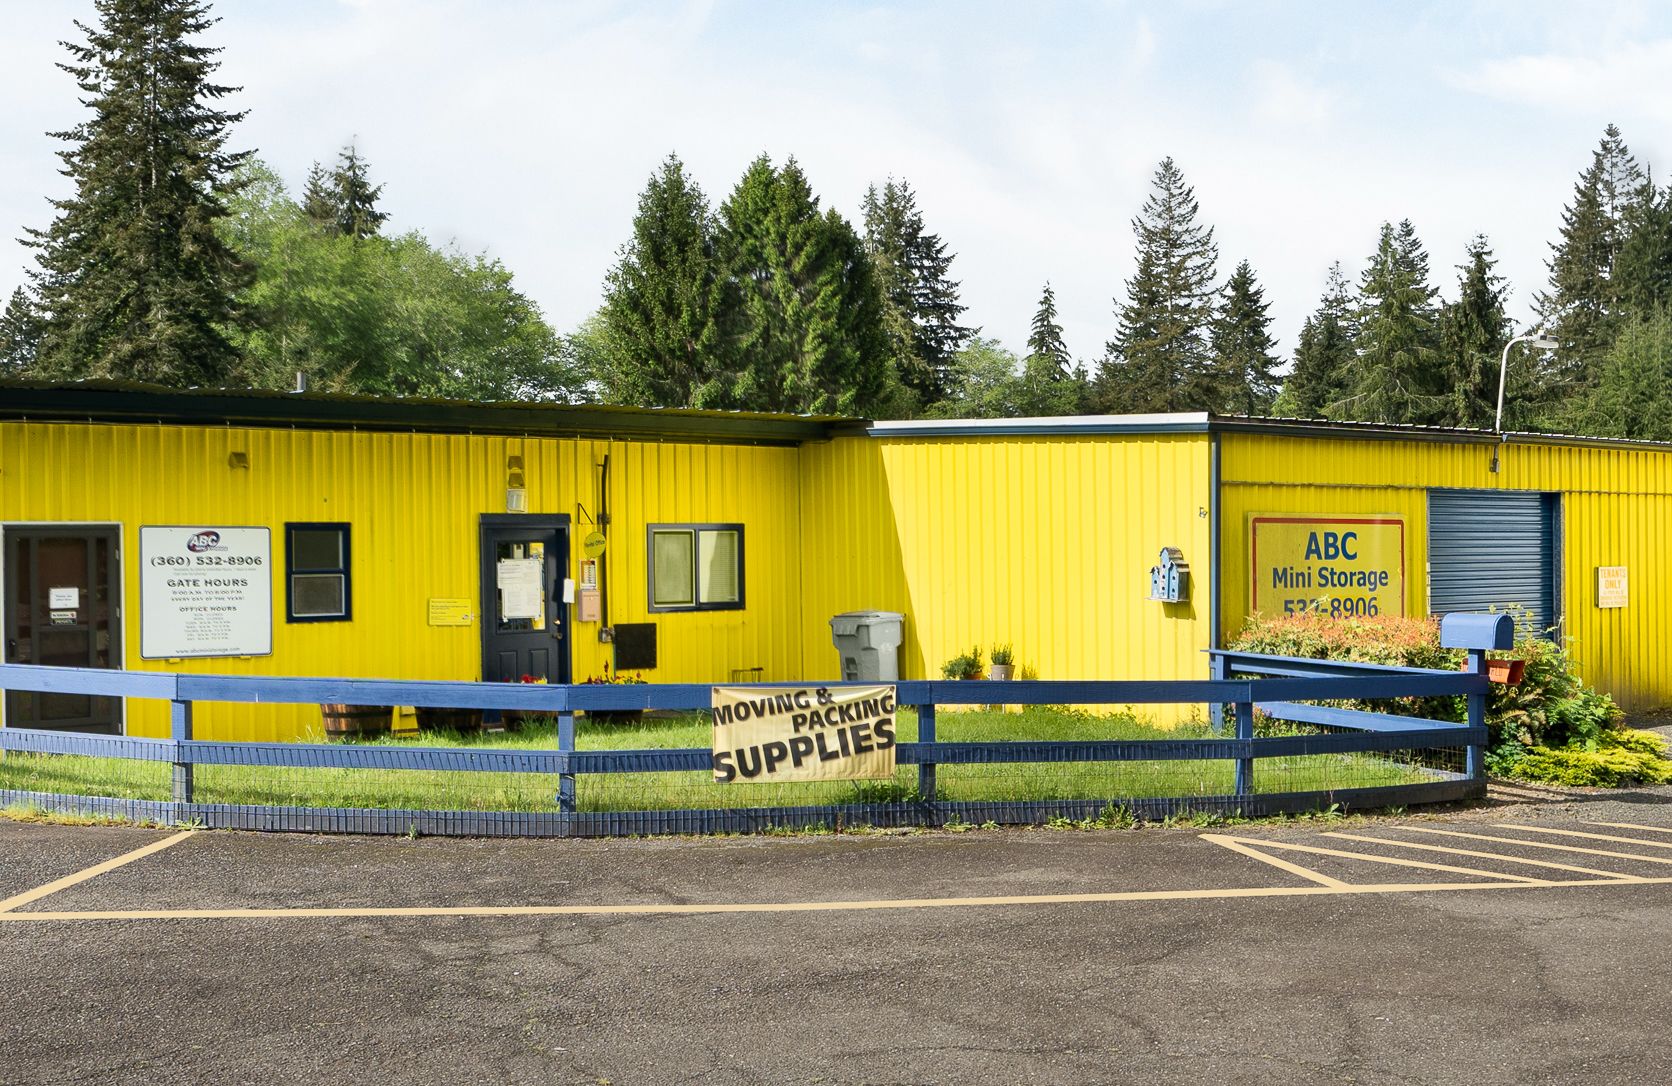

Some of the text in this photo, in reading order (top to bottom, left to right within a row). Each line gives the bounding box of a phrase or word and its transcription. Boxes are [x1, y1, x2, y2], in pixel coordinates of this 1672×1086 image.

[190, 535, 218, 547] ABC
[1305, 531, 1358, 560] ABC
[151, 556, 263, 567] (360) 532-8906
[167, 579, 248, 588] GATE HOURS
[1272, 566, 1389, 592] Mini Storage
[713, 687, 837, 727] MOVING &
[792, 695, 896, 733] PACKING
[714, 718, 896, 784] SUPPLIES
